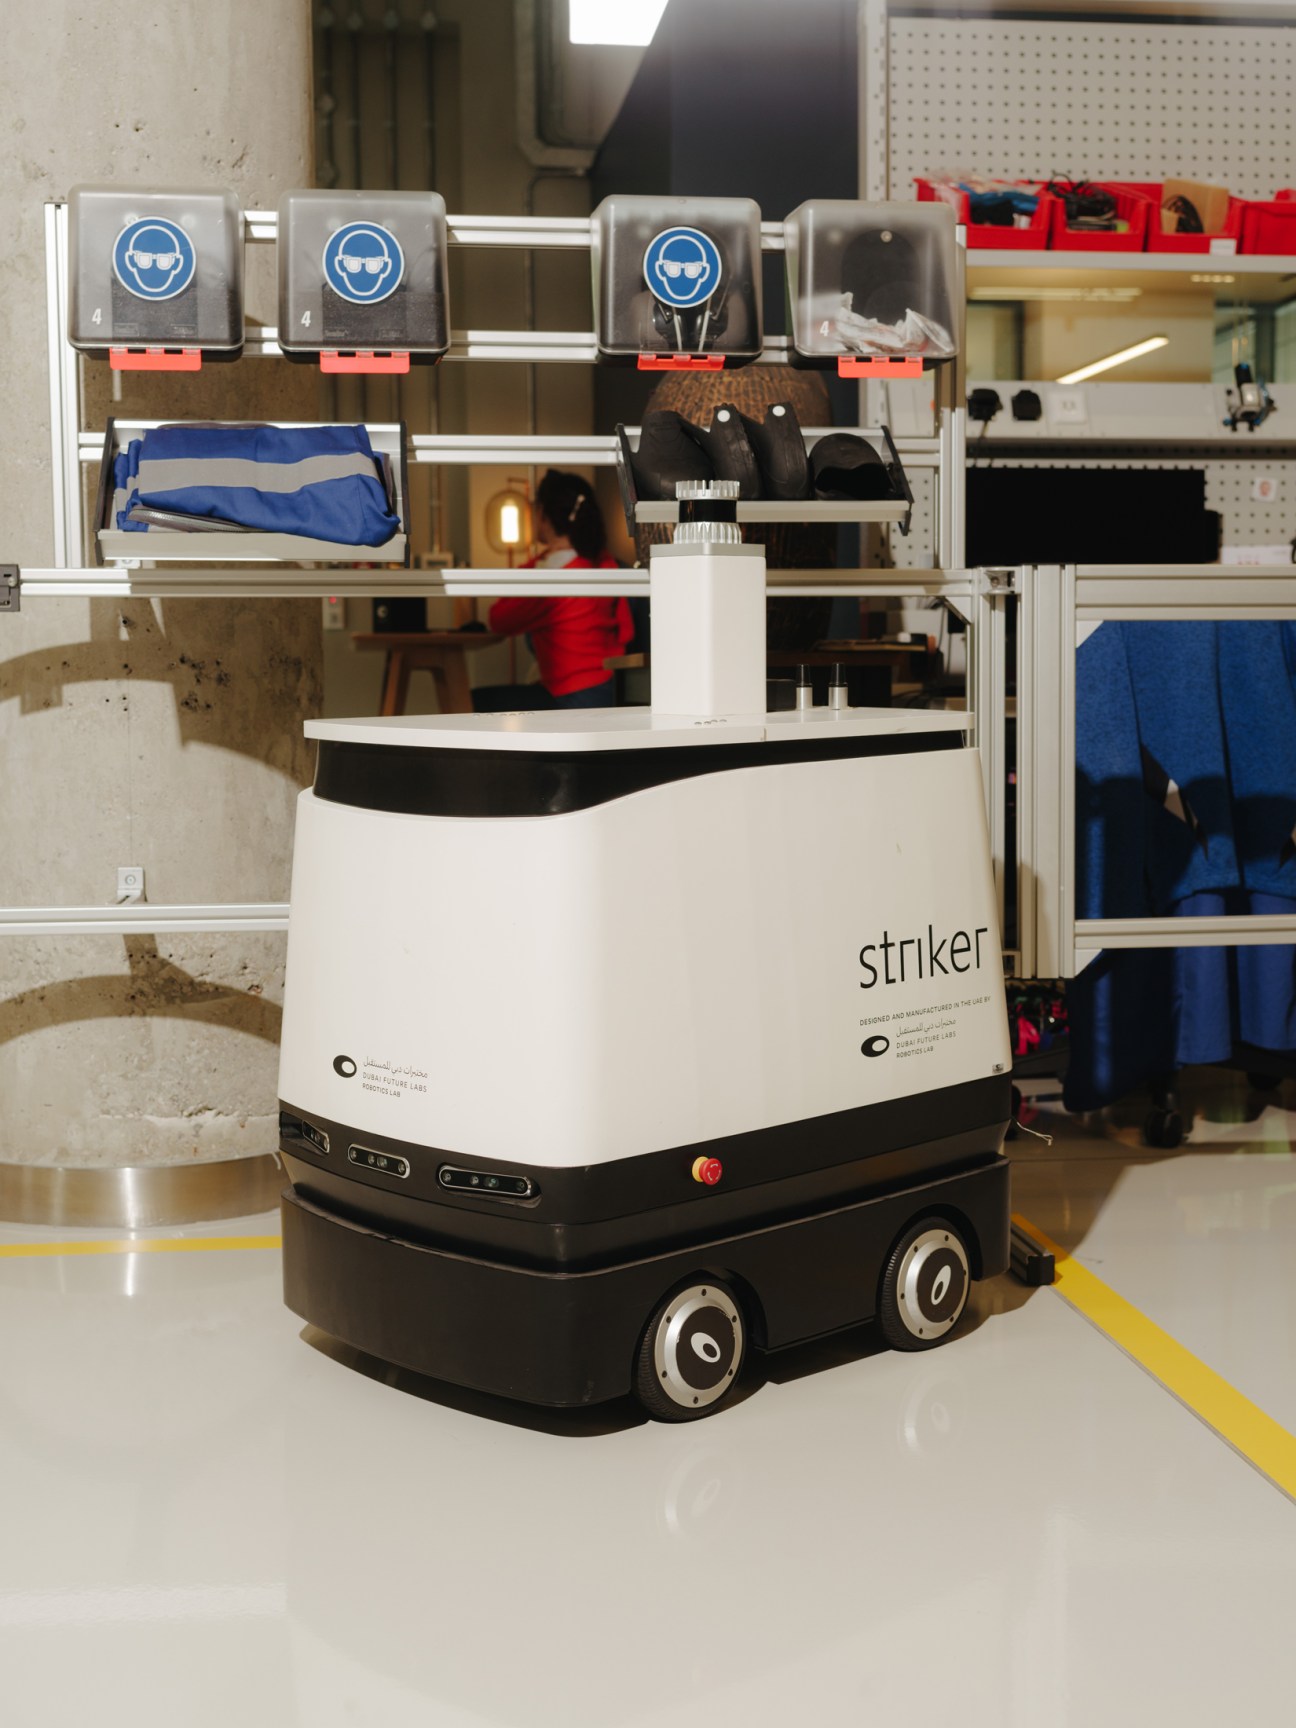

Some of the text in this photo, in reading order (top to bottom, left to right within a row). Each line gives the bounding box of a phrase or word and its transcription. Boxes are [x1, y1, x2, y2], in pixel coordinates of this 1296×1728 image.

[92, 308, 102, 325] 4
[301, 311, 311, 327] 4
[820, 320, 829, 336] 4
[859, 924, 988, 989] striker
[859, 1015, 890, 1026] DESIGNED
[892, 1012, 904, 1020] AND
[906, 1003, 952, 1018] MANUFACTURED
[961, 999, 971, 1007] THE
[972, 997, 983, 1005] UAE
[896, 1031, 956, 1049] DUBAI FUTURE LABS
[896, 1048, 922, 1058] ROBOTICS
[362, 1071, 427, 1093] DUBAI FUTURE LABS
[362, 1082, 401, 1098] ROBOTICS LAB
